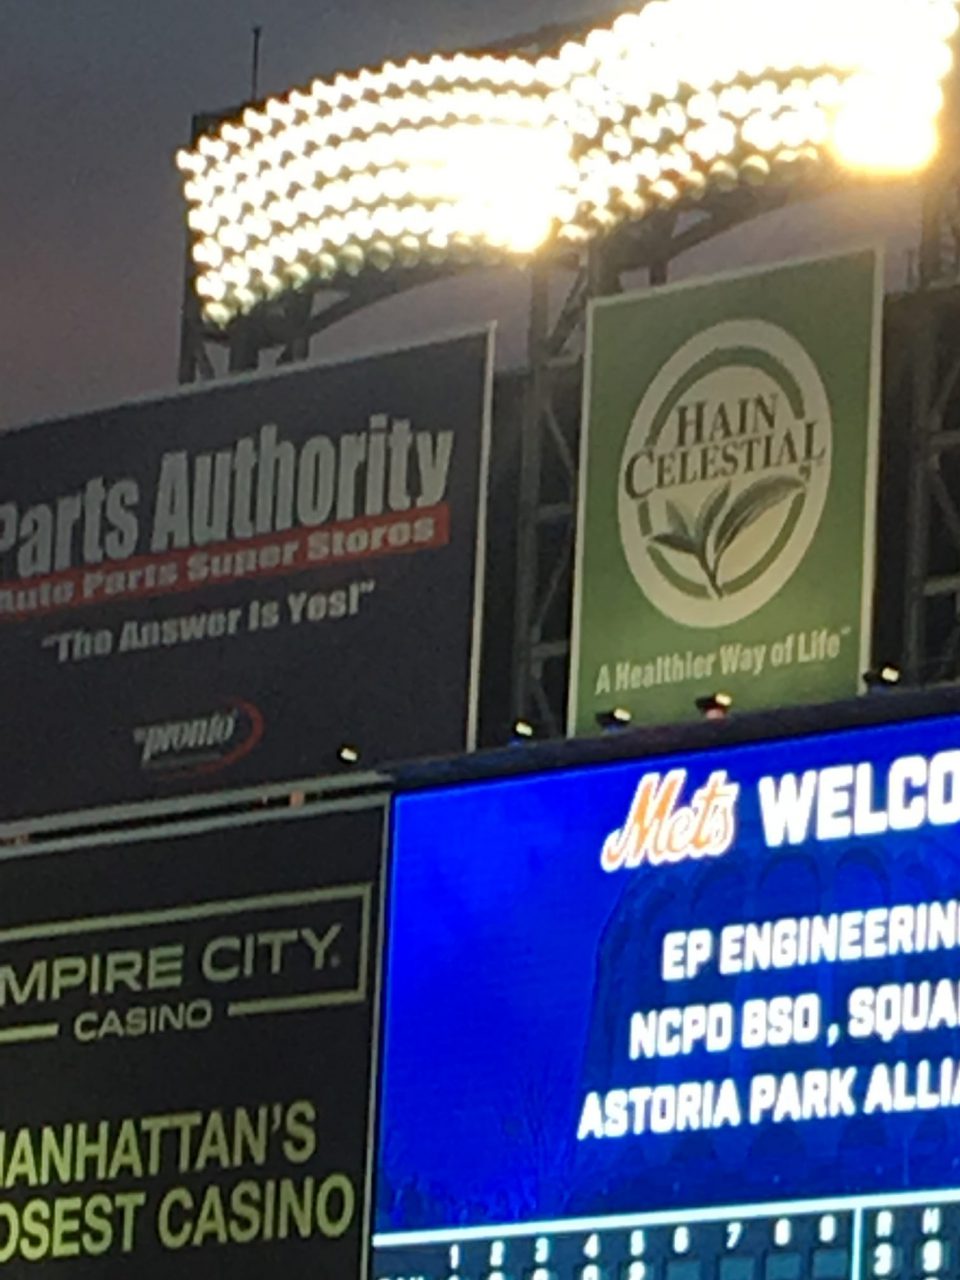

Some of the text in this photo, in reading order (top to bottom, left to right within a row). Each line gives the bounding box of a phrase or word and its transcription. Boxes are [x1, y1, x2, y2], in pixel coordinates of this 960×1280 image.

[676, 392, 778, 448] HAIN
[150, 413, 455, 553] Authority
[624, 420, 826, 499] CELESTIAL
[82, 561, 178, 599] Parts
[187, 540, 299, 580] Super
[306, 515, 436, 560] Stores
[118, 610, 242, 653] Answer
[248, 599, 280, 631] Is
[594, 663, 611, 696] A
[615, 651, 718, 692] Healthier
[719, 643, 768, 677] Way
[769, 632, 795, 668] of
[600, 767, 741, 873] Mets
[0, 923, 343, 1007] MPIRE CITY
[661, 928, 713, 981] EP
[74, 997, 213, 1042] CASINO
[629, 1001, 734, 1060] NCPD
[577, 1079, 742, 1140] ASTORIA
[748, 1066, 858, 1125] PARK
[0, 1100, 317, 1188] ANHATTAN'S
[157, 1173, 355, 1249] CASINO
[450, 1244, 459, 1269] 1
[490, 1241, 504, 1266] 2
[535, 1238, 548, 1263] 3
[584, 1234, 599, 1258] 4
[726, 1222, 742, 1248] 7
